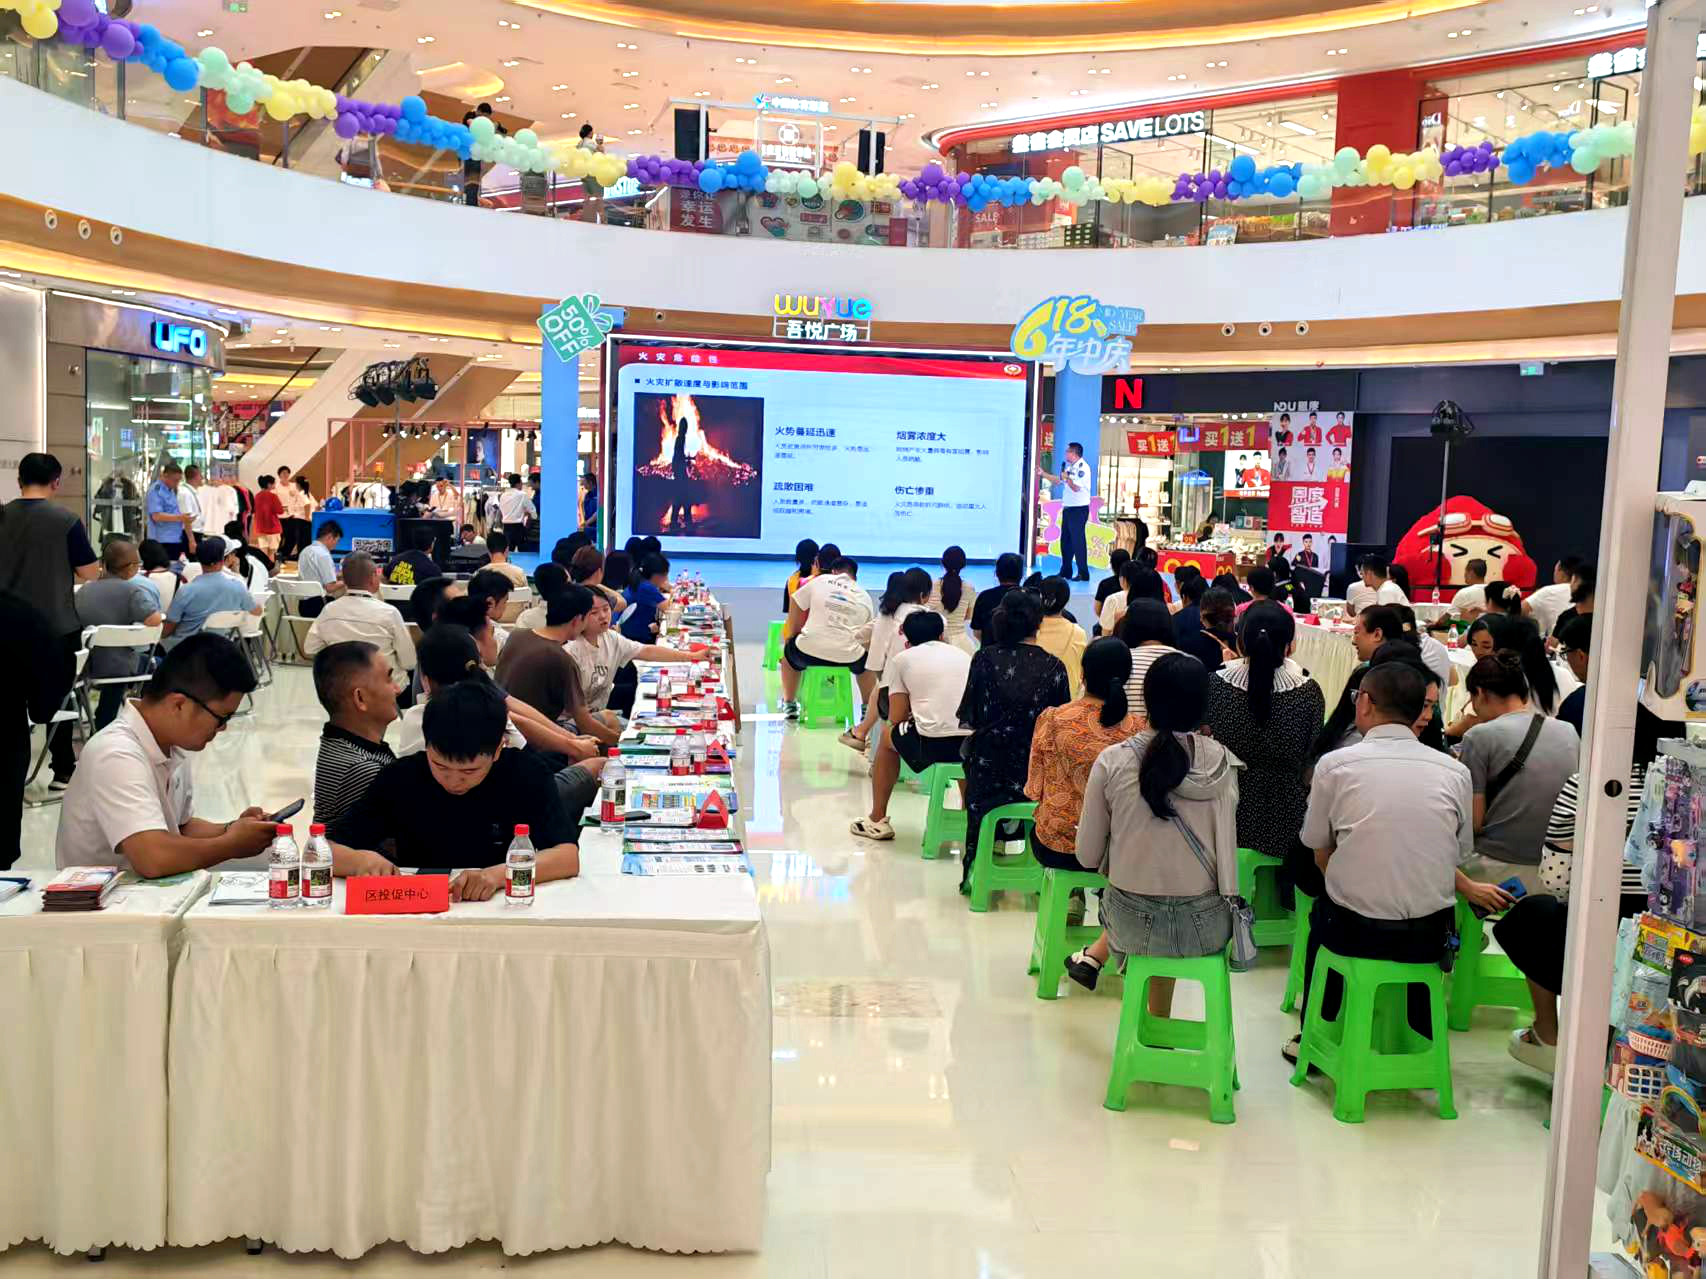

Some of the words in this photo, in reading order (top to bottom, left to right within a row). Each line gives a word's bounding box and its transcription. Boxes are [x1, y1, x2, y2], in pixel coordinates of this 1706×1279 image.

[154, 321, 207, 357] UFO
[544, 315, 580, 353] OFF
[561, 304, 596, 347] 50%
[786, 319, 857, 341] 吾悦广场
[1014, 298, 1097, 357] 618
[1048, 333, 1132, 374] 年中庆
[1114, 378, 1143, 409] N
[775, 426, 836, 438] 火势蔓延迅速
[896, 431, 947, 441] 烟雾浓度大
[1204, 425, 1257, 447] 买1送1
[365, 887, 429, 902] 区投促中心
